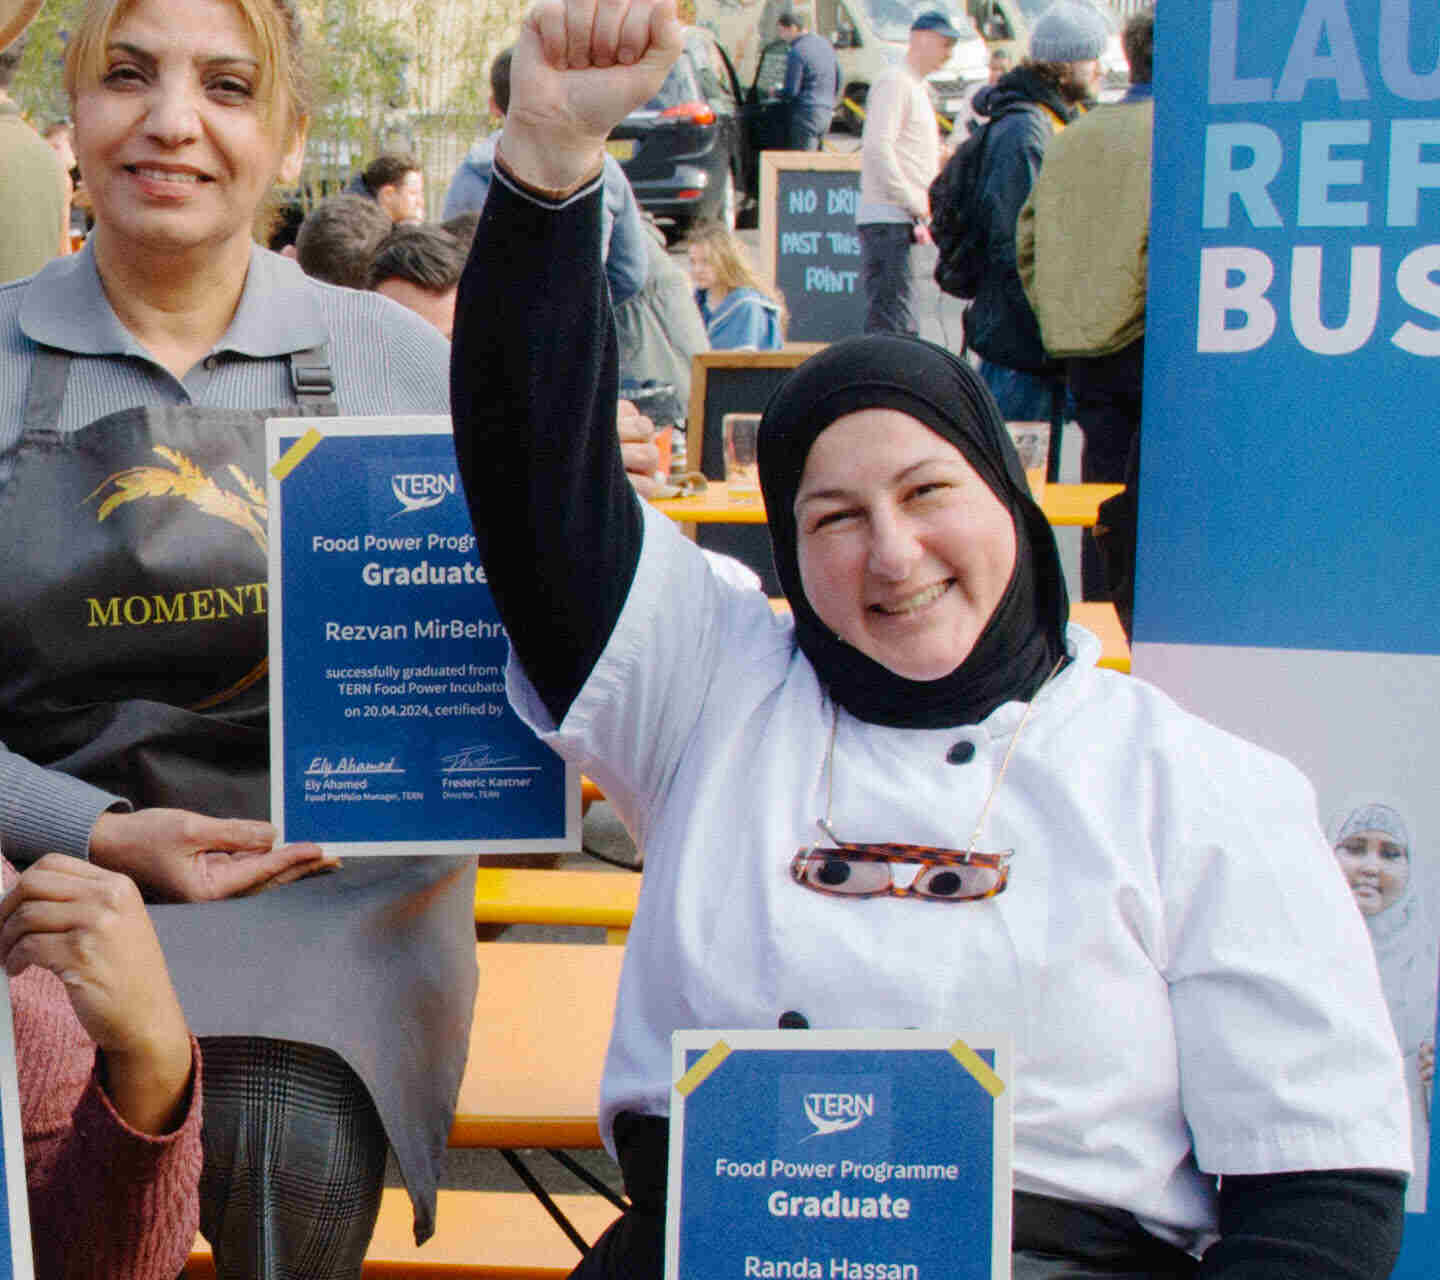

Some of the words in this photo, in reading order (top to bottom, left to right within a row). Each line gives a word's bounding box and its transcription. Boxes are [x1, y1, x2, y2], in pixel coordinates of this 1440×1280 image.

[789, 190, 818, 214] NO
[827, 188, 861, 214] DRI
[781, 232, 822, 255] PAST
[827, 232, 861, 255] THIS
[805, 265, 860, 293] POINT
[394, 473, 456, 495] TERN
[311, 535, 359, 552] Food
[364, 534, 422, 550] Power
[427, 533, 476, 552] Progr
[325, 621, 407, 640] Rezvan
[325, 664, 400, 680] successfully
[402, 663, 465, 679] graduated
[468, 663, 497, 675] from
[337, 683, 372, 696] TERN
[374, 682, 405, 695] Food
[408, 681, 447, 694] Power
[450, 680, 505, 693] Incubato
[344, 707, 360, 717] on
[434, 703, 485, 716] certified
[488, 703, 504, 716] by
[808, 1093, 874, 1117] TERN
[715, 1158, 767, 1177] Food
[771, 1159, 836, 1178] Power
[840, 1159, 959, 1182] Programme
[767, 1190, 911, 1219] Graduate
[744, 1255, 823, 1280] Randa
[829, 1257, 919, 1280] Hassan
